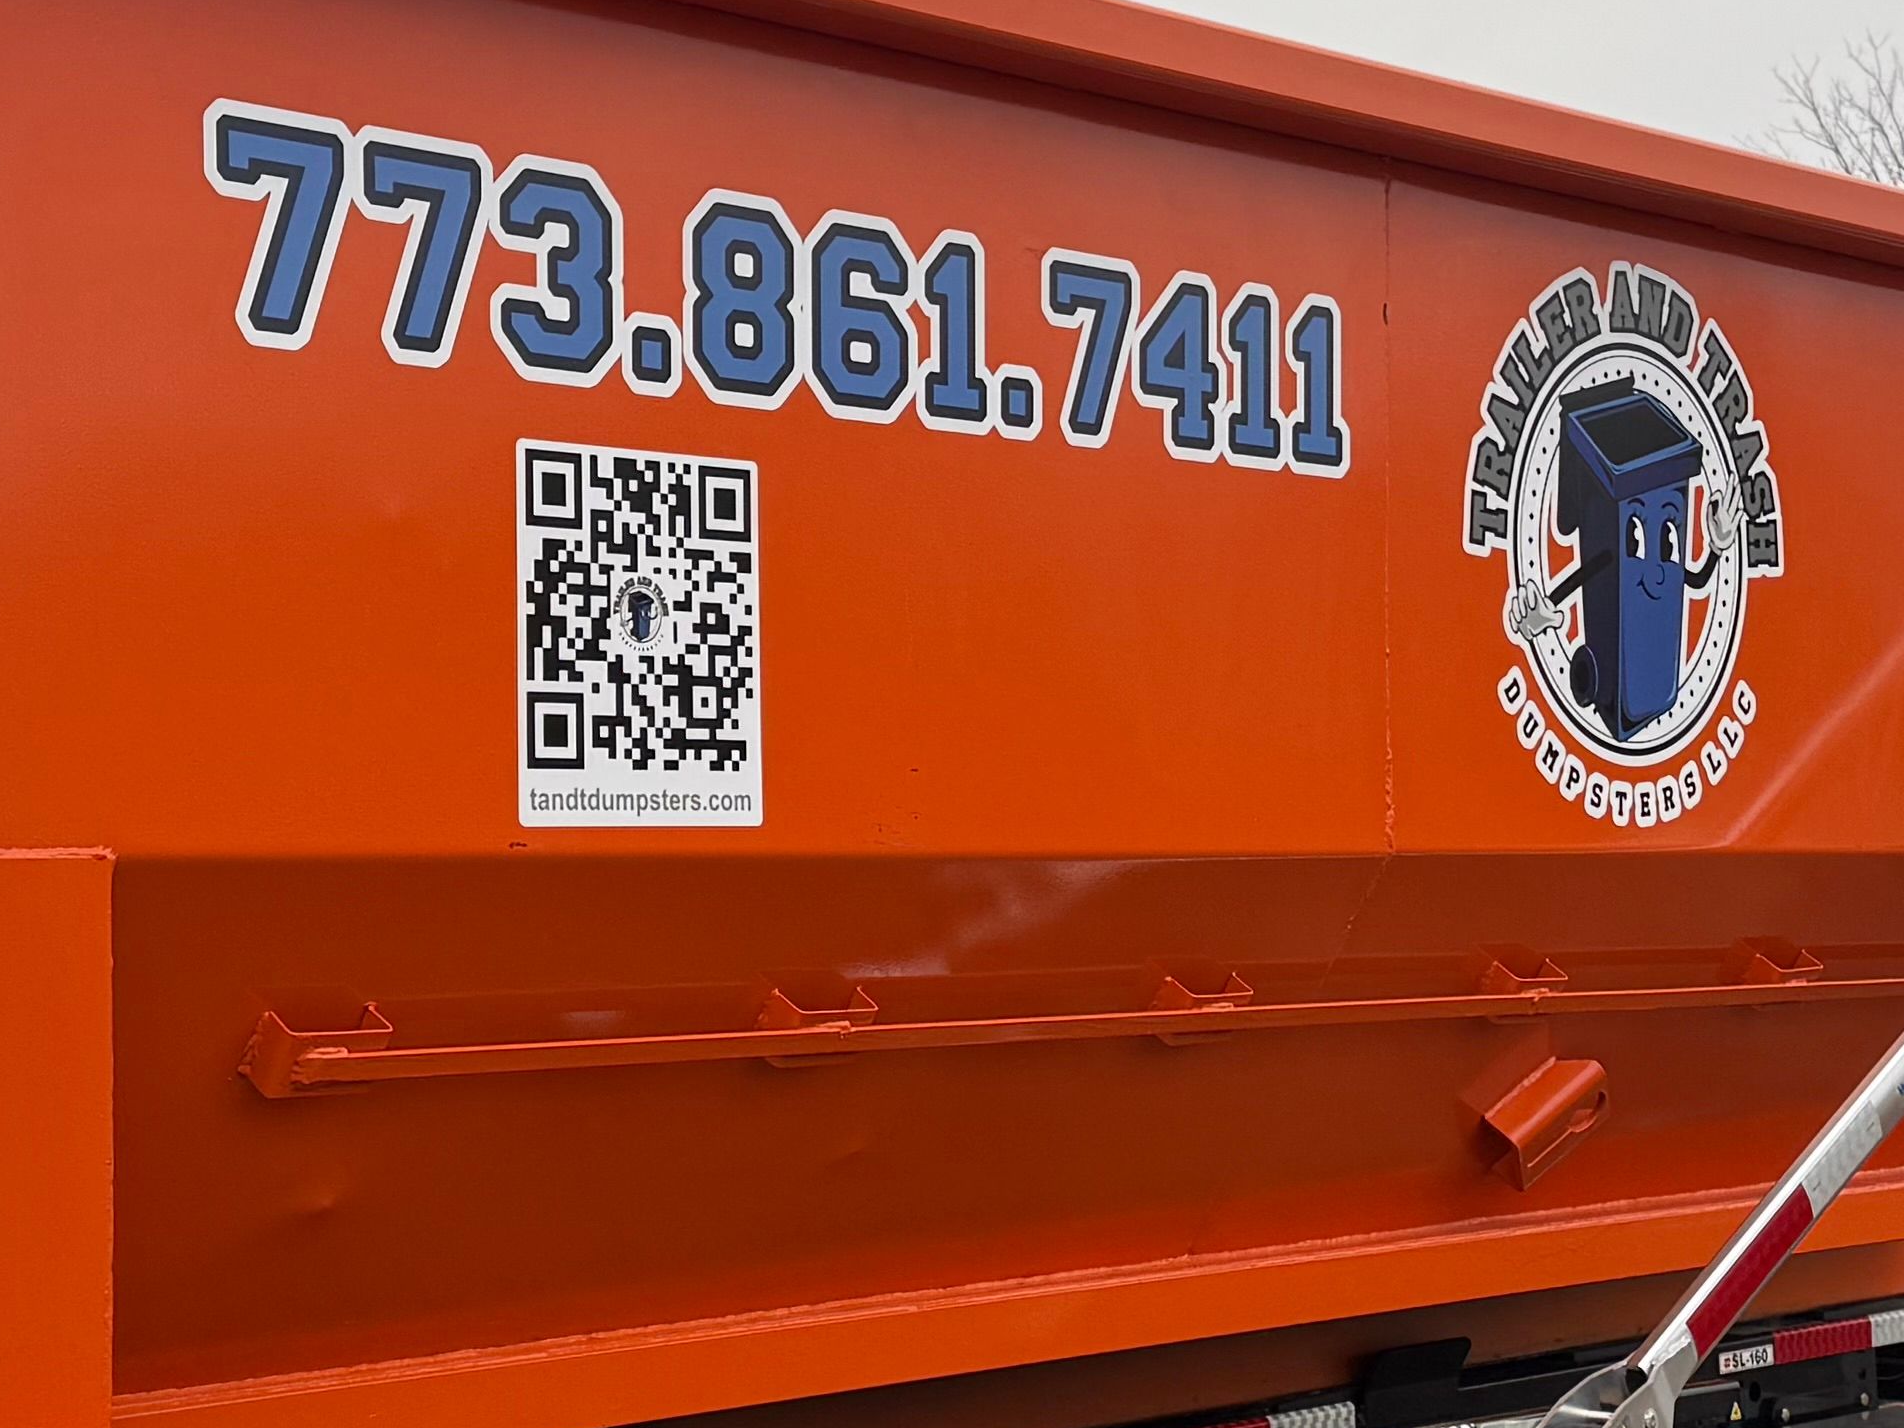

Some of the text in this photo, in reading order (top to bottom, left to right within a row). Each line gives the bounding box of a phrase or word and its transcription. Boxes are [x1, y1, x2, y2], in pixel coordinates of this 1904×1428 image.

[212, 111, 1344, 469] 773.861.7411
[1469, 277, 1601, 546] TRAILER
[1609, 270, 1694, 358] AND
[1697, 328, 1780, 568] TRASH
[529, 787, 752, 816] tandtdumpsters.com
[1504, 677, 1752, 818] DUMPSTERS LLC
[1732, 1347, 1769, 1369] SL-160
